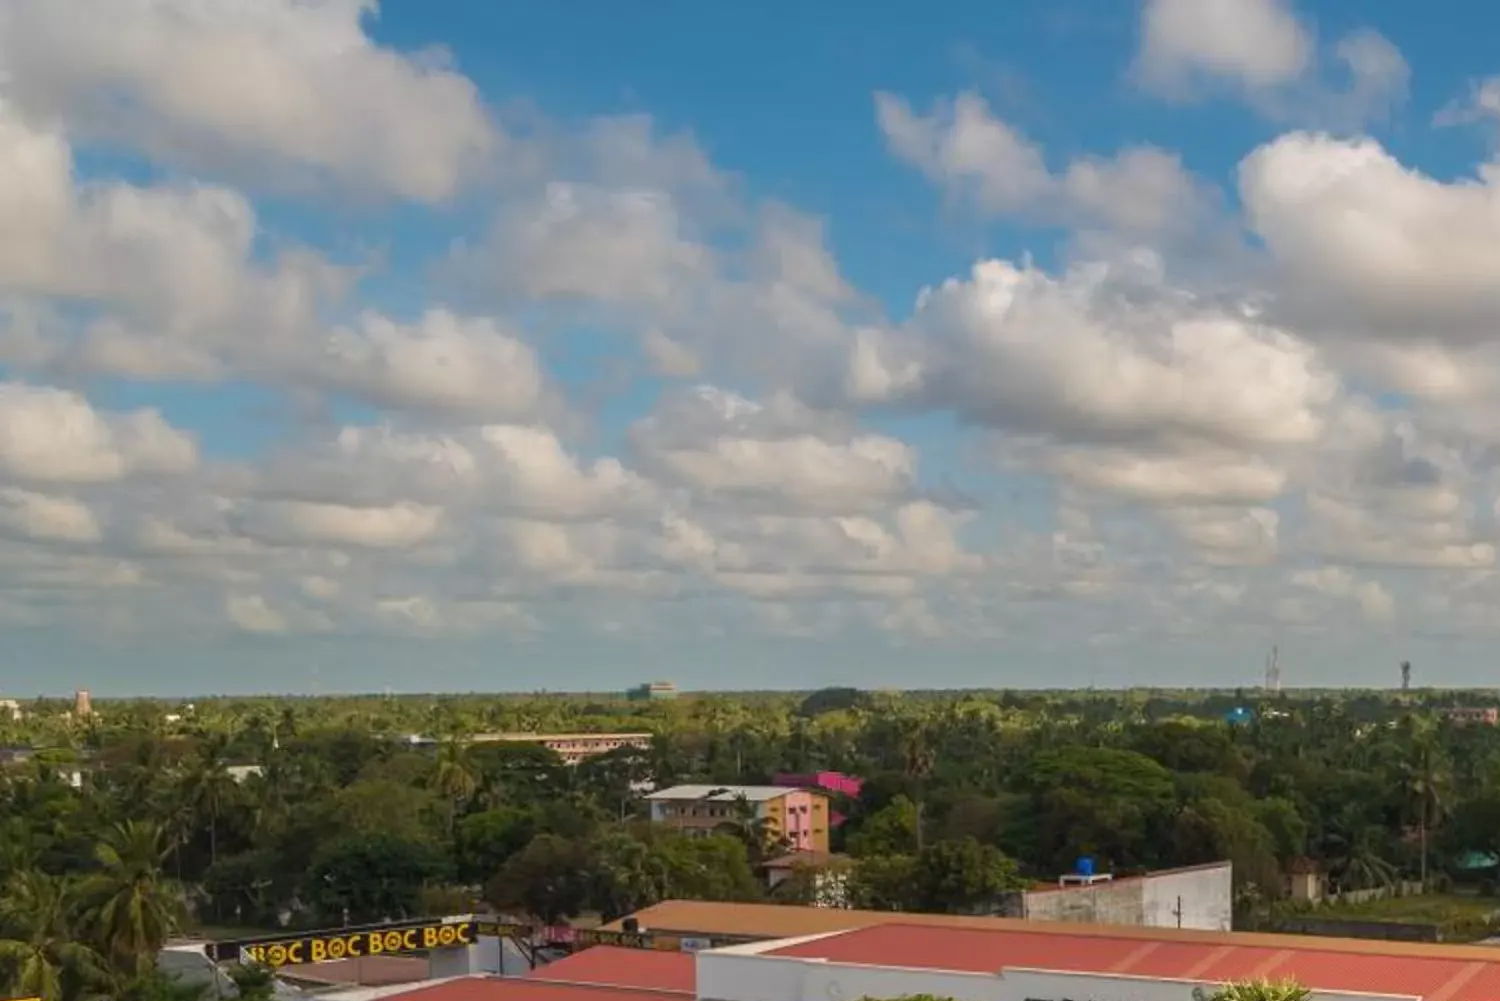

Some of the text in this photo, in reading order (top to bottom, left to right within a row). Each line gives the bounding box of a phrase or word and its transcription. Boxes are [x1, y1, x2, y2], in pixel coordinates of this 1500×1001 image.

[311, 935, 361, 961] BOC
[369, 929, 417, 954] BOC
[424, 923, 470, 947] BOC
